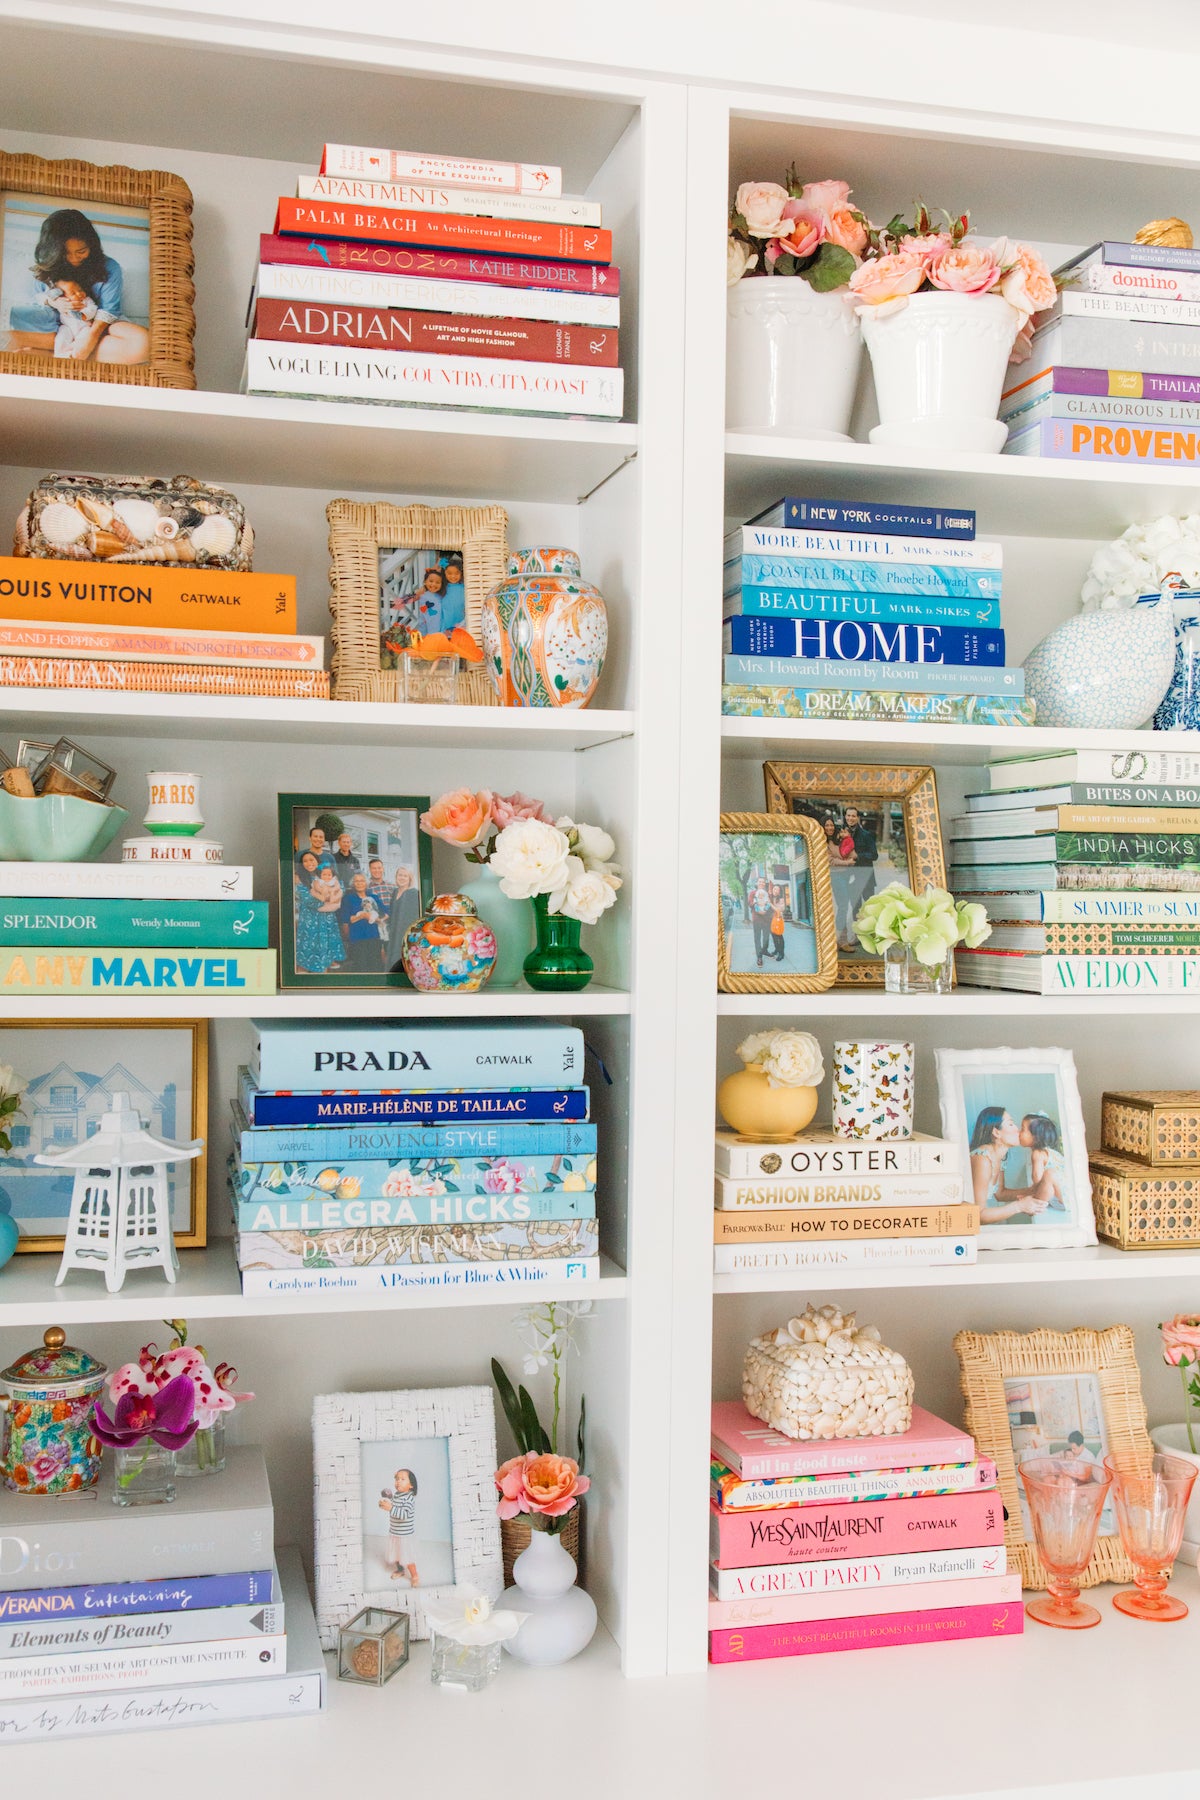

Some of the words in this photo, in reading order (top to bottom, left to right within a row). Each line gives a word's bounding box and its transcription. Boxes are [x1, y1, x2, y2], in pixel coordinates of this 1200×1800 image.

[420, 160, 495, 172] ENCYCLOPEDIA
[451, 172, 504, 183] EXQUISITE
[312, 178, 449, 207] APARTMENTS
[295, 207, 346, 225] PALM
[354, 213, 418, 233] BEACH
[426, 222, 439, 231] An
[442, 223, 502, 238] Architectural
[504, 230, 543, 243] Heritage
[469, 259, 515, 277] KATIE
[519, 264, 580, 283] RIDDER
[1112, 270, 1178, 291] domino
[273, 271, 363, 296] INVITING
[371, 280, 480, 305] INTERIORS
[1080, 298, 1111, 310] THE
[1115, 301, 1168, 315] BEAUTY
[278, 306, 412, 343] ADRIAN
[428, 325, 459, 333] LIFETIME
[467, 336, 484, 344] HIGH
[485, 338, 515, 346] FASHION
[268, 356, 329, 376] VOGUE
[334, 361, 397, 380] LIVING
[535, 377, 589, 395] COAST
[1067, 400, 1164, 418] GLAMOROUS
[1072, 424, 1200, 461] PROVEN
[810, 507, 838, 520] NEW
[842, 509, 872, 523] YORK
[874, 514, 933, 525] COCKTAILS
[754, 533, 801, 549] MORE
[805, 536, 894, 555] BEAUTIFUL
[902, 545, 933, 556] MARK
[943, 548, 974, 558] SIKES
[760, 564, 829, 581] COASTAL
[832, 569, 877, 582] BLUES
[886, 572, 924, 585] Phoebe
[927, 574, 969, 588] Howard
[59, 582, 152, 604] VUITTON
[180, 592, 241, 605] CATWALK
[275, 591, 287, 614] Yale
[760, 592, 881, 615] BEAUTIFUL
[889, 604, 922, 614] MARK
[935, 606, 971, 617] SIKES
[49, 634, 110, 648] HOPPING
[112, 638, 171, 650] AMANDA
[173, 640, 245, 654] LINDROTH
[246, 644, 293, 657] DESIGN
[791, 618, 945, 665] HOME
[0, 657, 128, 686] RATTAN
[739, 659, 766, 673] Mrs.
[769, 660, 820, 676] Howard
[823, 663, 861, 677] Room
[864, 664, 878, 682] by
[882, 665, 919, 680] Room
[805, 693, 872, 712] DREAM
[879, 695, 953, 714] MAKERS
[151, 784, 195, 805] PARIS
[1086, 787, 1132, 800] BITES
[1135, 788, 1158, 801] ON
[1161, 789, 1173, 802] A
[151, 847, 192, 861] RHUM
[1077, 837, 1130, 853] INDIA
[1135, 839, 1194, 855] HICKS
[1073, 901, 1144, 916] SUMMER
[1147, 903, 1161, 914] TO
[3, 914, 98, 929] SPLENDOR
[131, 917, 162, 929] Wendy
[164, 918, 201, 928] Moonan
[1133, 935, 1174, 943] SCHEERER
[3, 955, 87, 987] ANY
[92, 957, 246, 987] MARVEL
[1051, 960, 1159, 989] AVEDON
[314, 1051, 432, 1072] PRADA
[475, 1055, 533, 1065] CATWALK
[562, 1046, 574, 1072] Yale
[317, 1098, 433, 1116] MARIE-HÉLÈNE
[437, 1100, 458, 1113] DE
[461, 1099, 527, 1113] TAILLAC
[278, 1142, 314, 1151] VARVEL
[791, 1150, 899, 1172] OYSTER
[736, 1185, 809, 1205] FASHION
[813, 1184, 882, 1203] BRANDS
[251, 1199, 418, 1230] ALLEGRA
[430, 1194, 531, 1223] HICKS
[791, 1221, 826, 1232] HOW
[830, 1220, 849, 1231] TO
[853, 1217, 928, 1230] DECORATE
[302, 1237, 378, 1259] DAVID
[386, 1232, 502, 1255] WISEMAN
[733, 1253, 789, 1268] PRETTY
[795, 1250, 848, 1266] ROOMS
[268, 1277, 317, 1293] Carolyne
[319, 1276, 358, 1288] Roehm
[376, 1274, 387, 1287] A
[391, 1271, 440, 1287] Passion
[443, 1270, 461, 1284] for
[465, 1270, 494, 1283] Blue
[495, 1268, 507, 1282] &
[508, 1266, 548, 1281] White
[751, 1460, 771, 1475] all
[775, 1459, 791, 1473] in
[793, 1455, 828, 1474] good
[831, 1454, 867, 1468] taste
[745, 1487, 805, 1502] ABSOLUTELY
[807, 1483, 858, 1496] BEAUTIFUL
[860, 1479, 899, 1492] THINGS
[905, 1476, 934, 1487] ANNA
[936, 1474, 965, 1485] SPIRO
[907, 1518, 958, 1531] CATWALK
[985, 1508, 995, 1532] Yale
[0, 1536, 81, 1576] Dior
[787, 1548, 814, 1557] haute
[816, 1545, 848, 1555] couture
[732, 1577, 745, 1594] A
[750, 1570, 818, 1593] GREAT
[824, 1563, 885, 1586] PARTY
[894, 1563, 926, 1579] Bryan
[929, 1558, 976, 1574] Rafanelli
[0, 1595, 76, 1617] VERANDA
[83, 1587, 193, 1609] Entertaining
[9, 1629, 90, 1648] Elements
[93, 1624, 114, 1645] of
[113, 1622, 173, 1640] Beauty
[772, 1637, 790, 1646] THE
[792, 1634, 818, 1644] MOST
[820, 1629, 871, 1642] BEAUTIFUL
[870, 1625, 902, 1637] ROOMS
[903, 1624, 913, 1633] IN
[916, 1623, 933, 1632] THE
[934, 1619, 967, 1631] WORLD
[69, 1661, 112, 1674] MUSEUM
[113, 1660, 126, 1670] OF
[130, 1659, 148, 1668] ART
[149, 1653, 196, 1667] COSTUME
[197, 1650, 247, 1663] INSTITUTE
